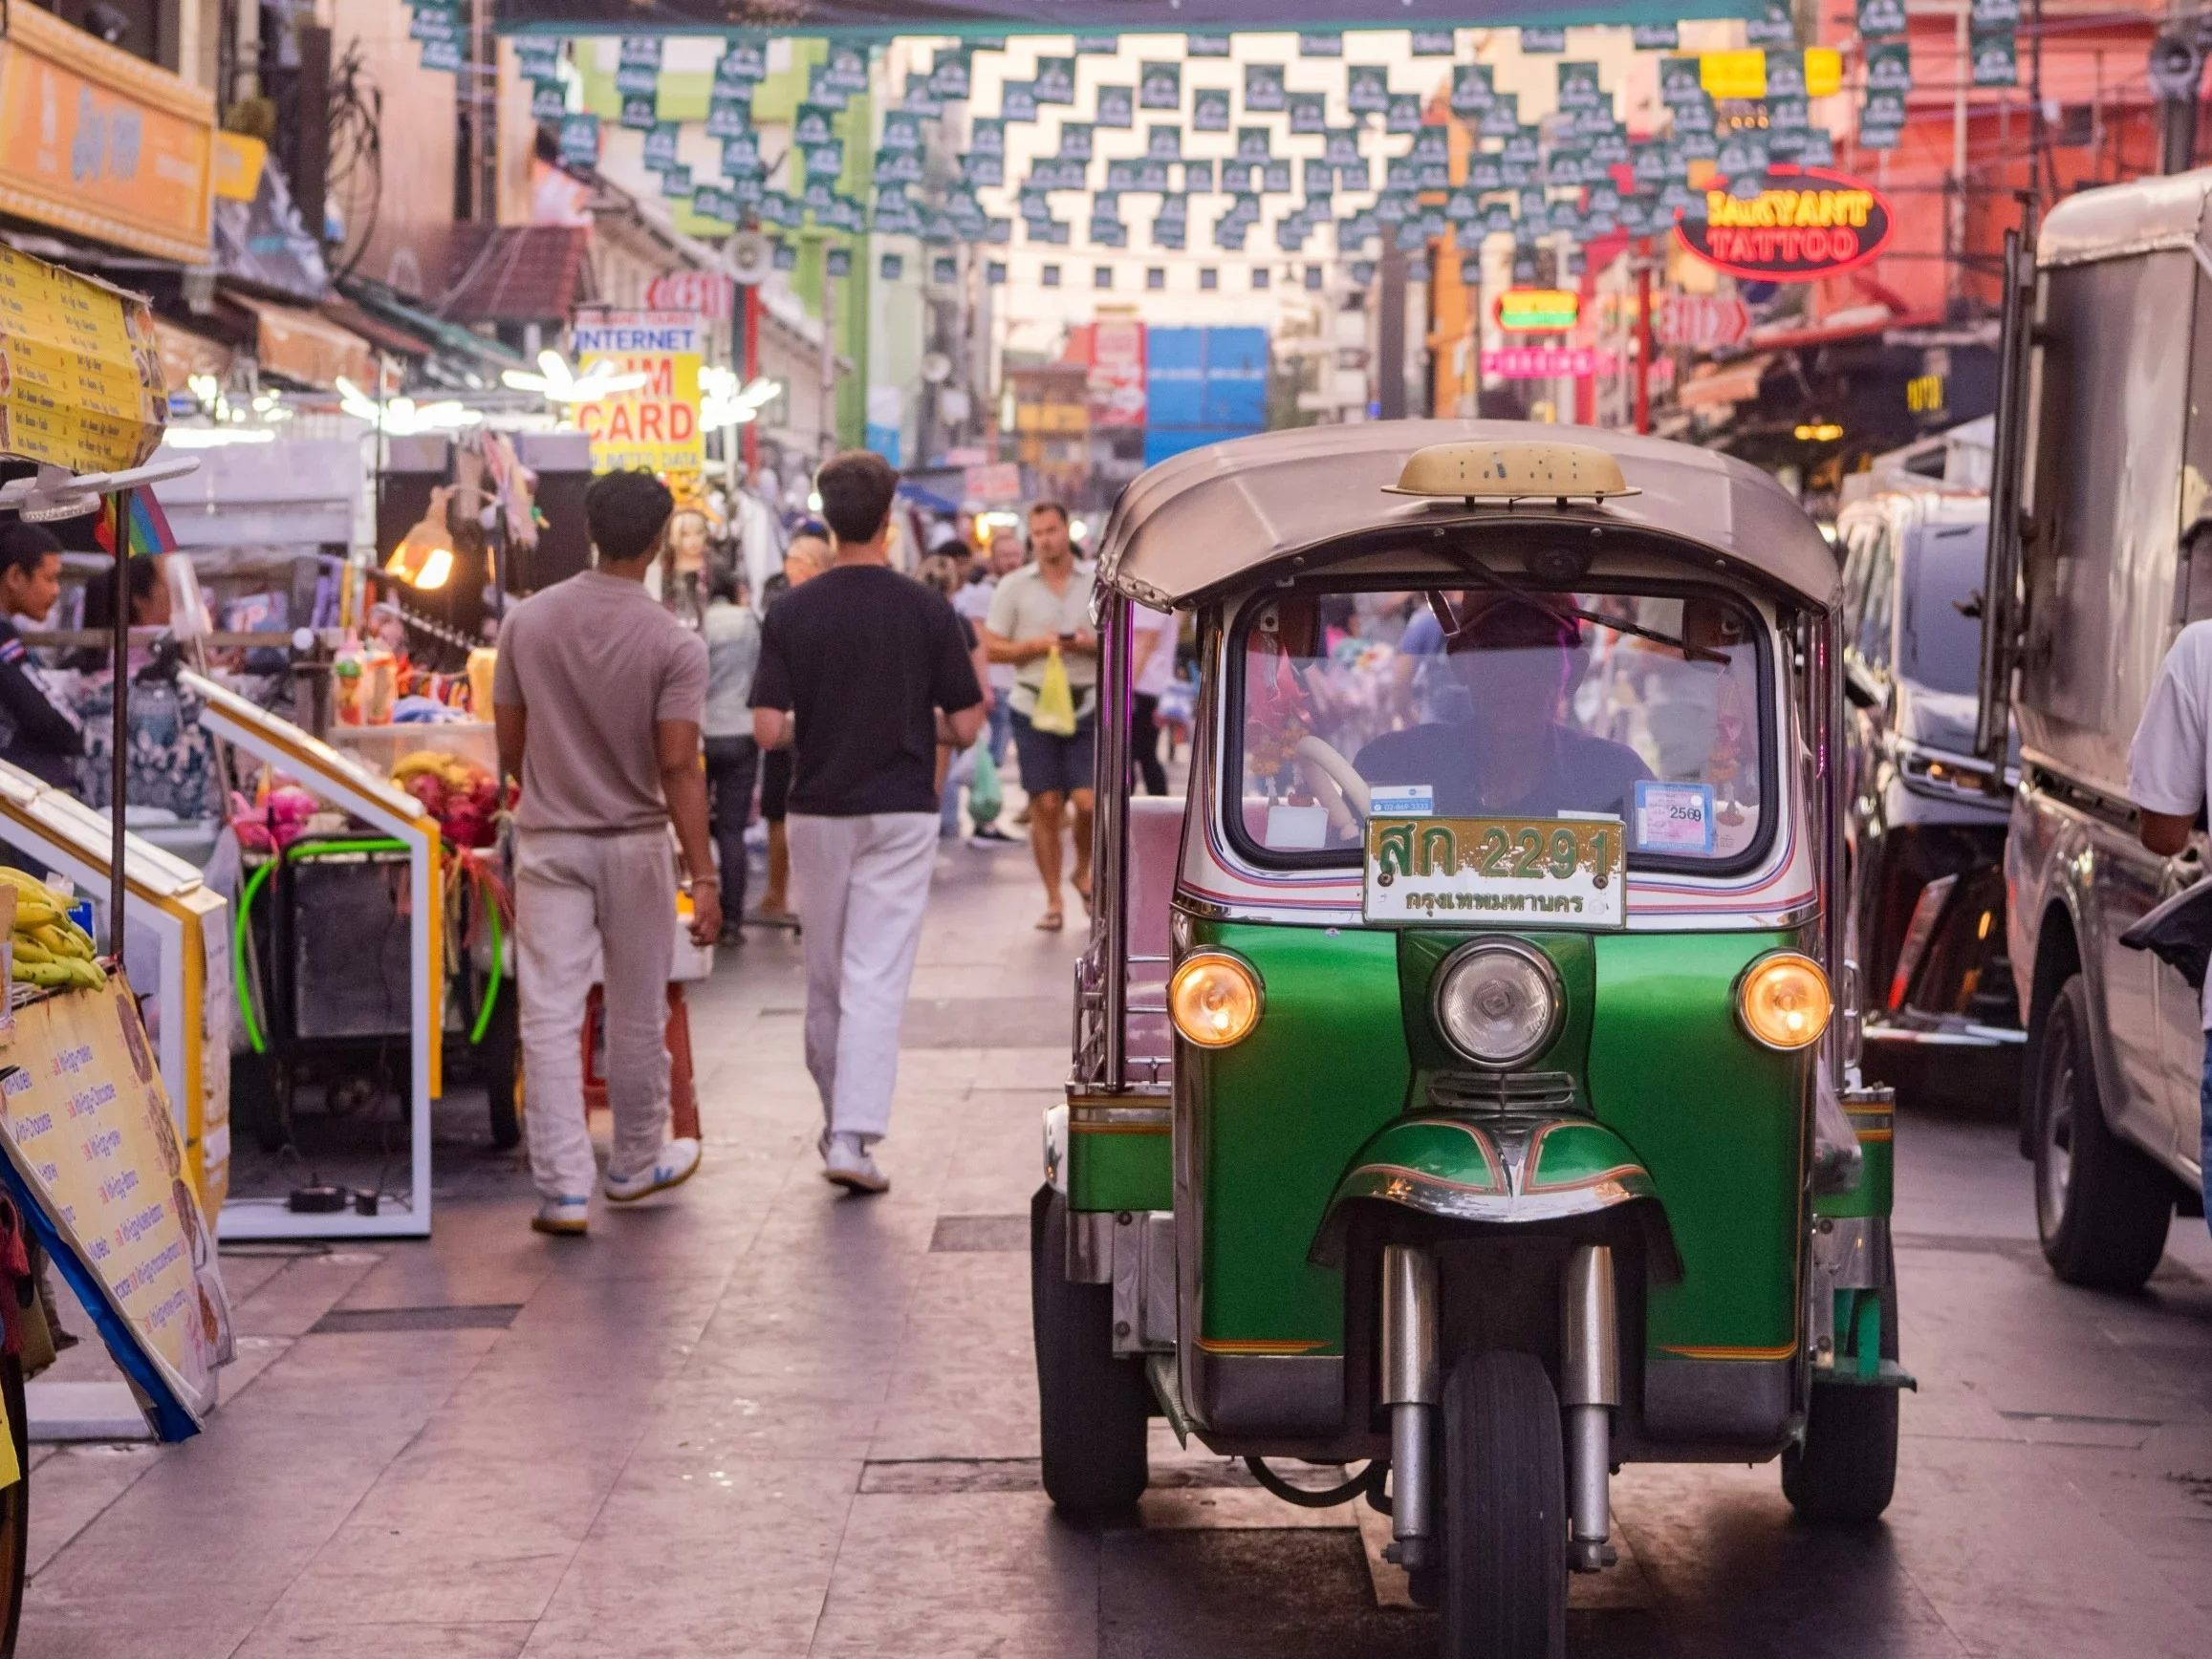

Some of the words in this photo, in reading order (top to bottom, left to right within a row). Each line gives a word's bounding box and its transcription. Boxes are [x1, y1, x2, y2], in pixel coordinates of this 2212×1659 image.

[1706, 226, 1859, 263] TATTOO
[575, 329, 694, 351] INTERNET
[578, 402, 694, 443] CARD
[1670, 806, 1702, 822] 2569
[1379, 821, 1457, 878] สก
[1480, 826, 1608, 879] 2291
[1405, 891, 1584, 918] กรุงเทพมหานคร
